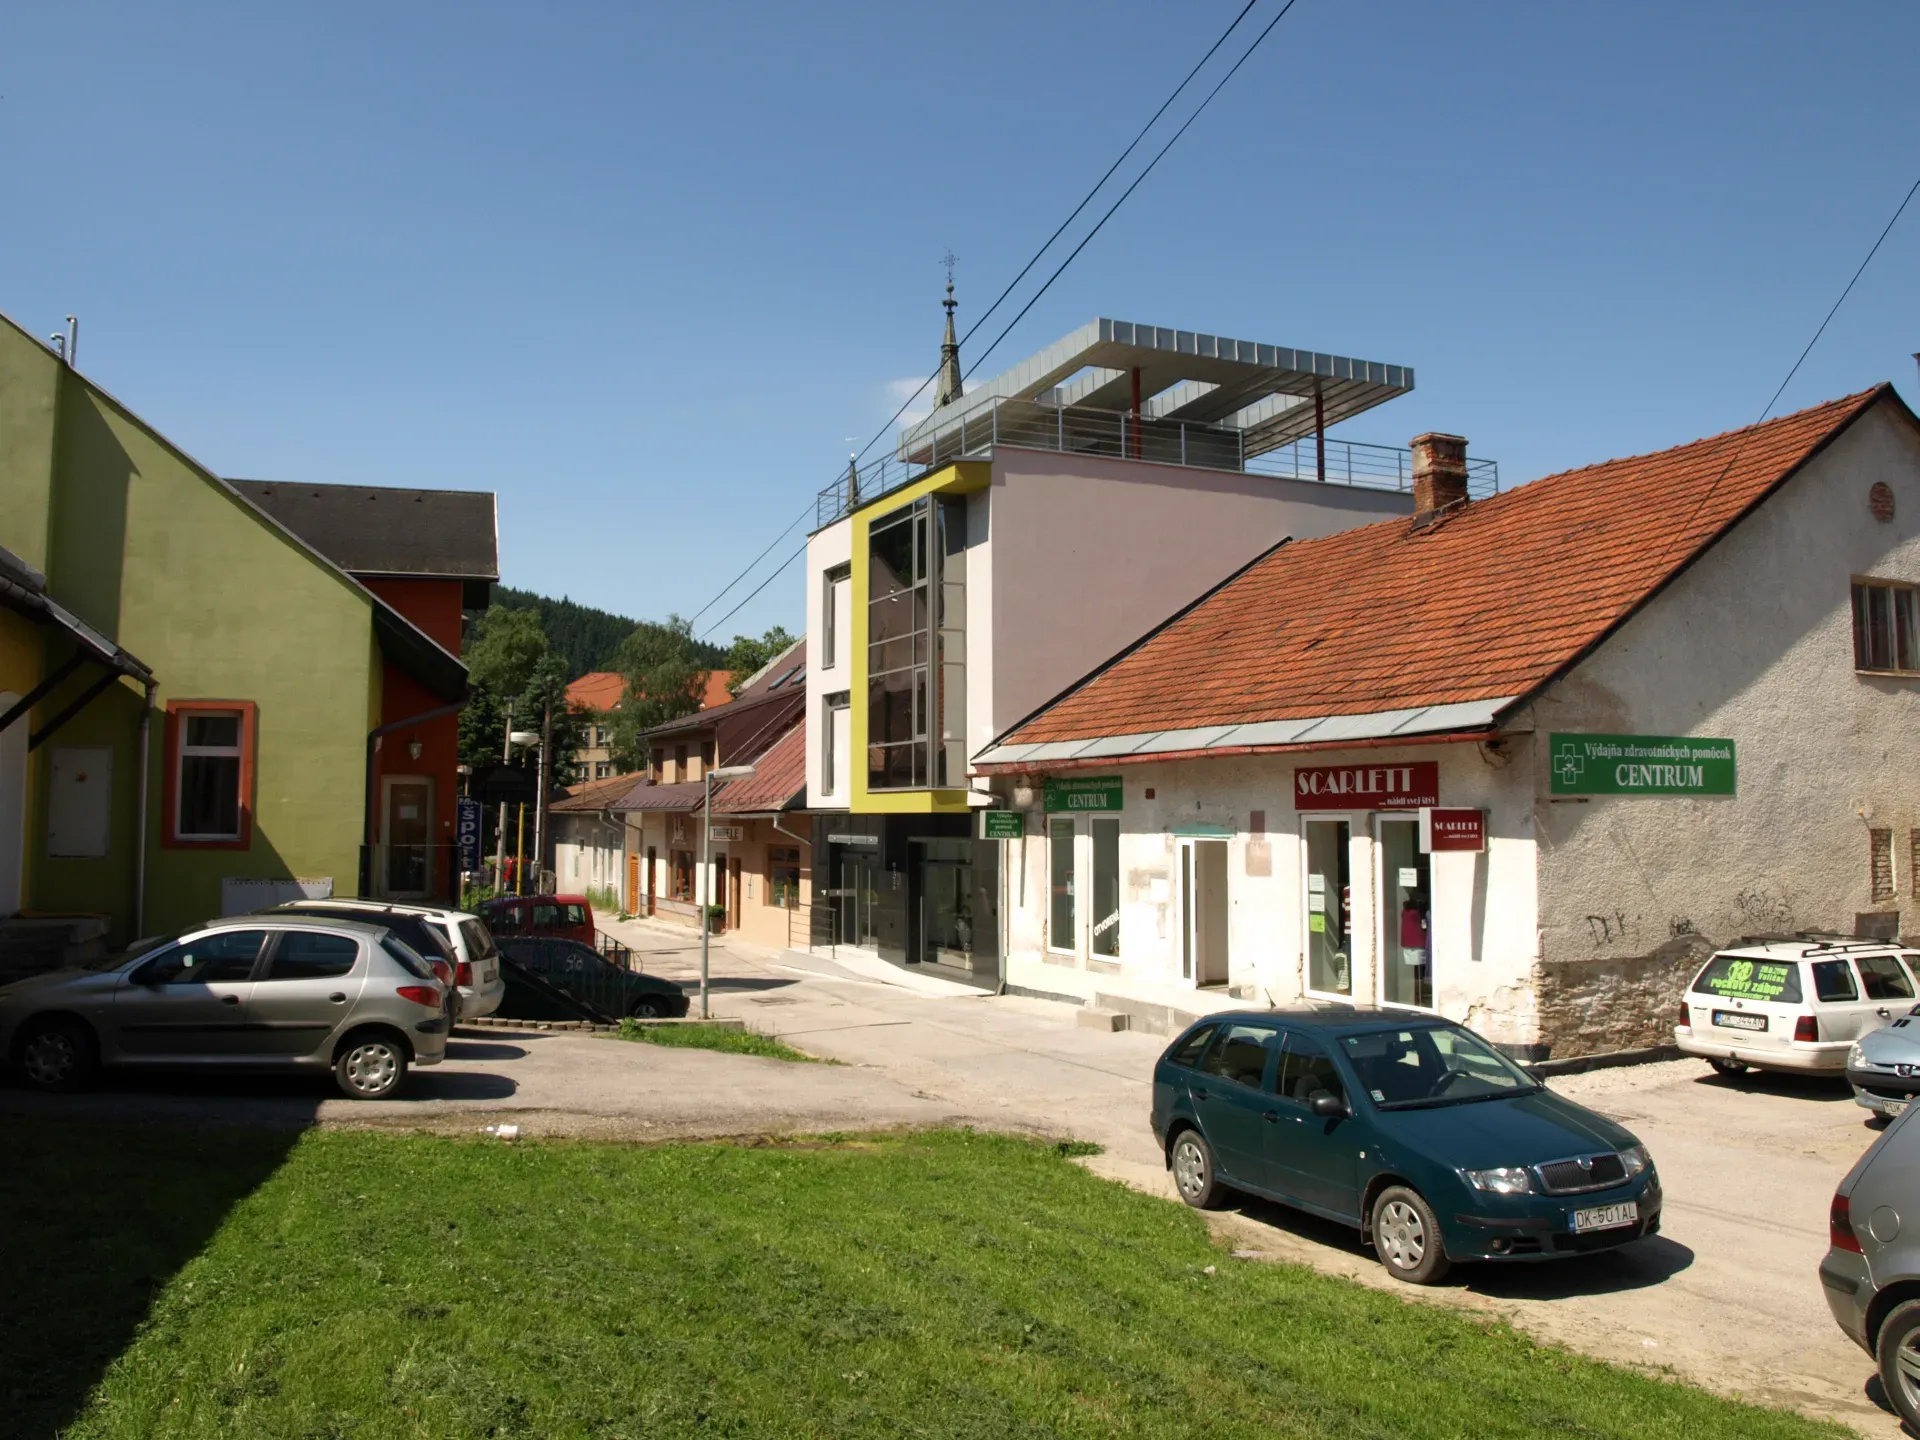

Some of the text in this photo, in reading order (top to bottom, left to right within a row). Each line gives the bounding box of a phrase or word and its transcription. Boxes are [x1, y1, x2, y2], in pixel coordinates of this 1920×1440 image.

[1584, 743, 1731, 761] Výdajňa zdravotníckych pomôcok
[1297, 768, 1414, 796] SCARLETT
[1615, 764, 1704, 787] CENTRUM
[1067, 793, 1107, 808] CENTRUM
[1434, 822, 1478, 830] SCARLETT
[1576, 1203, 1636, 1228] DK-501AL
